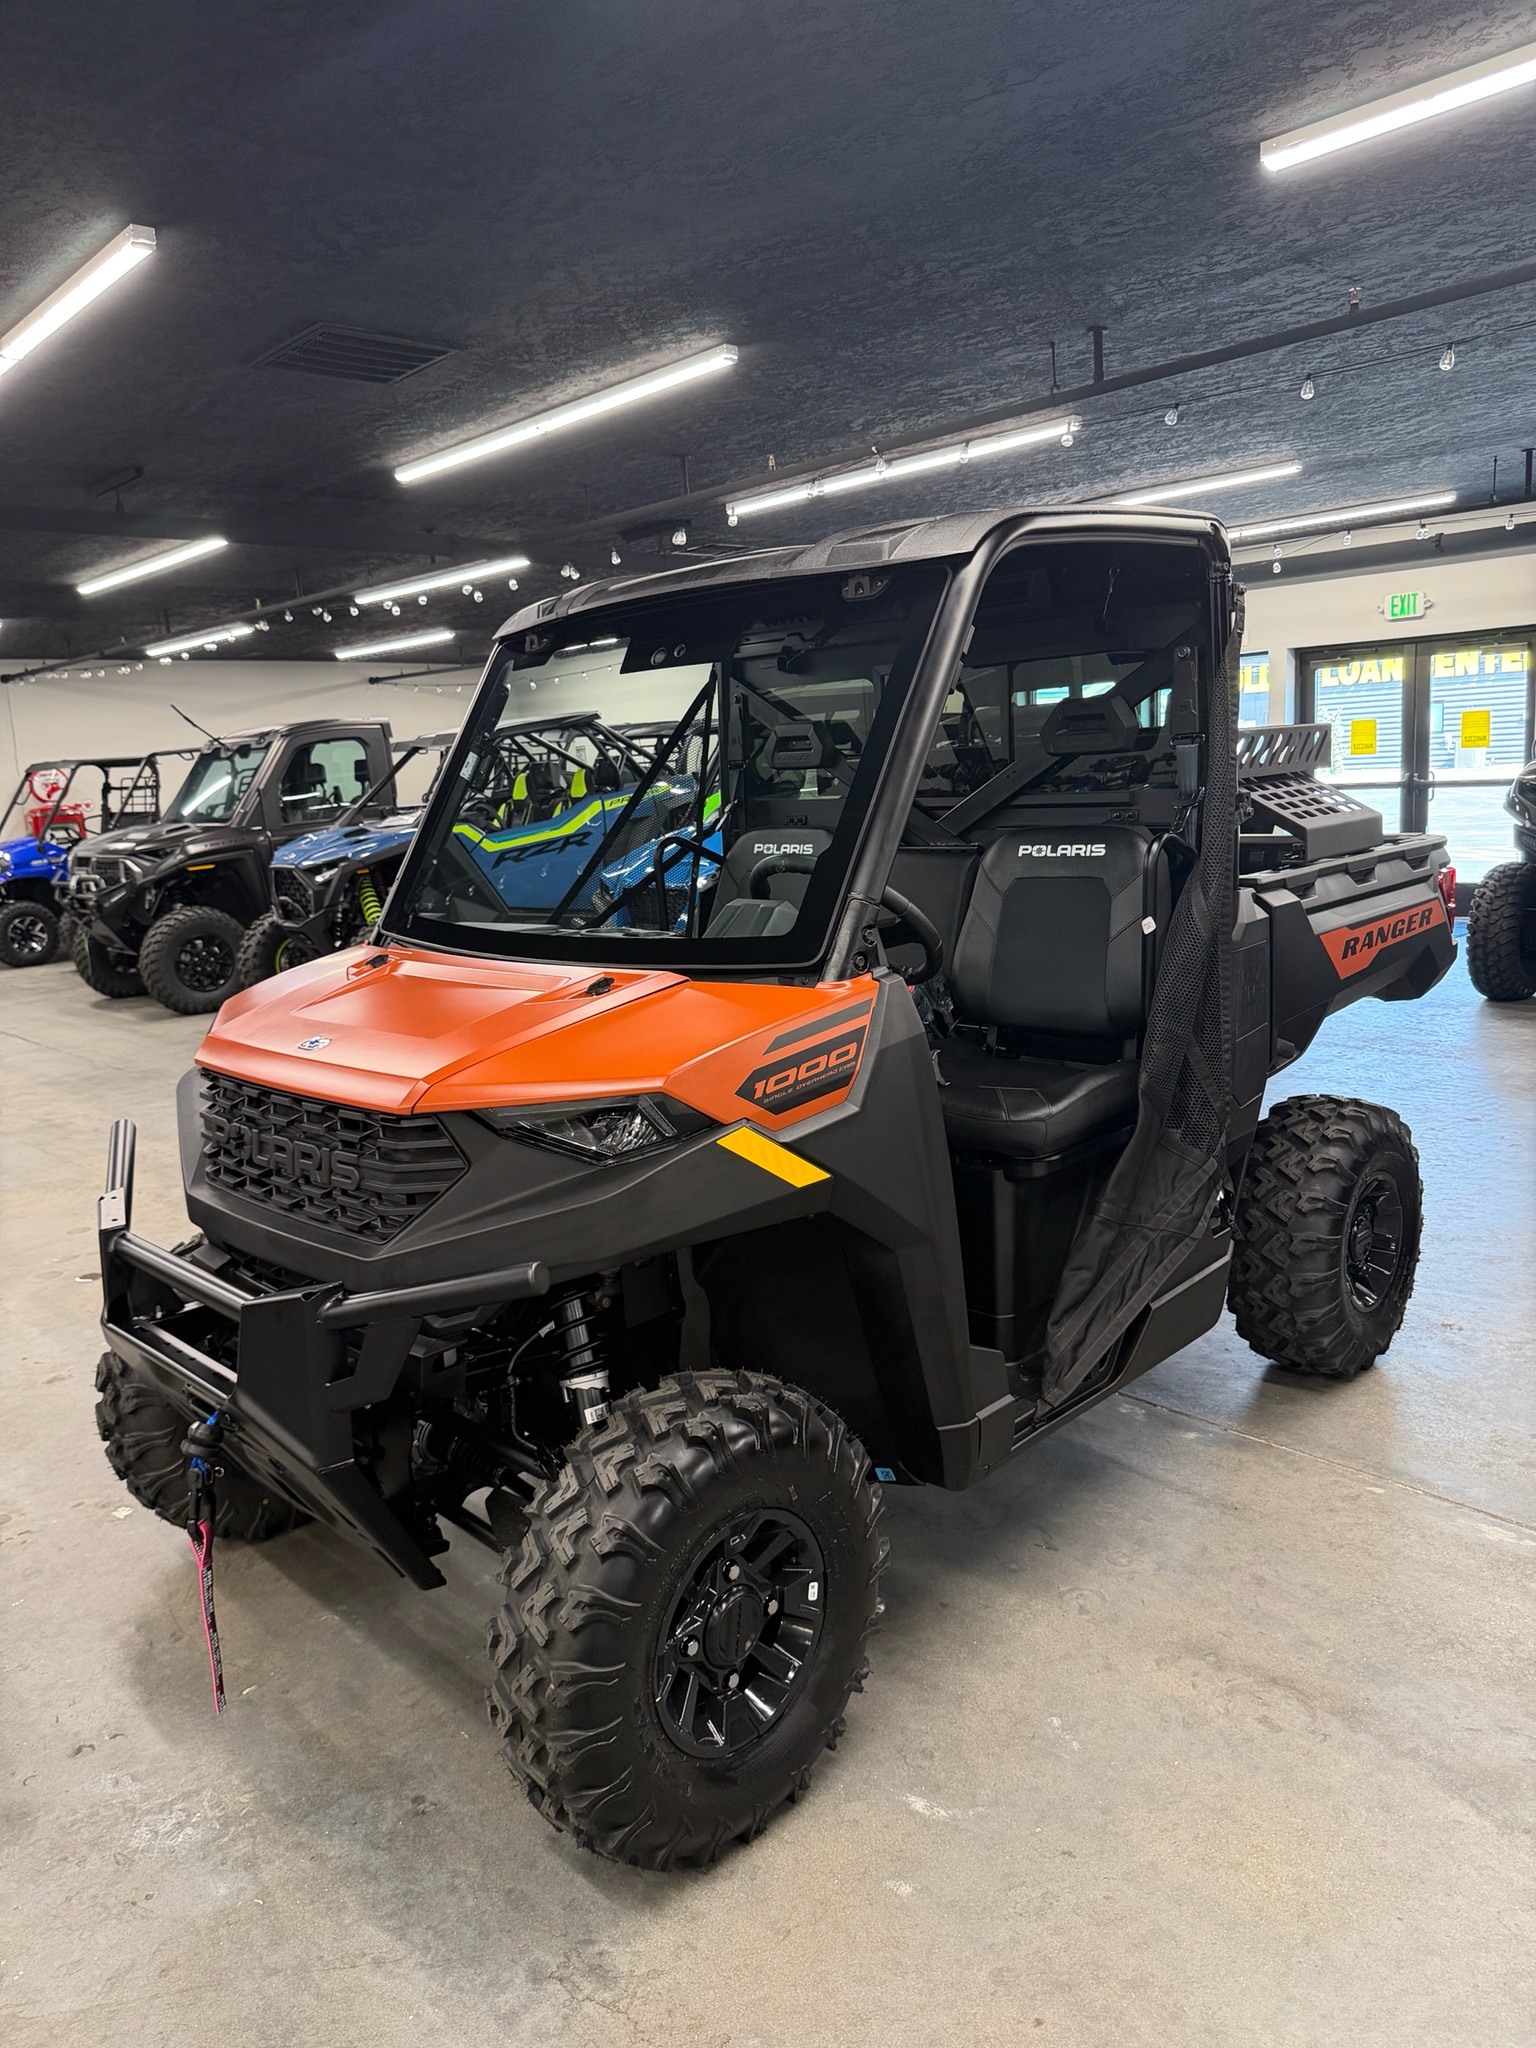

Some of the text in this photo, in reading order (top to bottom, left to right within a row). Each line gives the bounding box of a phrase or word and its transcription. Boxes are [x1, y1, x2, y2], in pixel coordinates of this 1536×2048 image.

[1390, 593, 1419, 617] EXIT
[490, 831, 593, 871] RZR
[753, 843, 814, 856] POLARIS
[1018, 844, 1106, 857] POLARIS
[1341, 906, 1433, 960] RANGER
[753, 1042, 857, 1099] 1000
[763, 1088, 794, 1104] SINGLE
[796, 1069, 838, 1090] OVERHEAD
[210, 1115, 362, 1192] POLARIS
